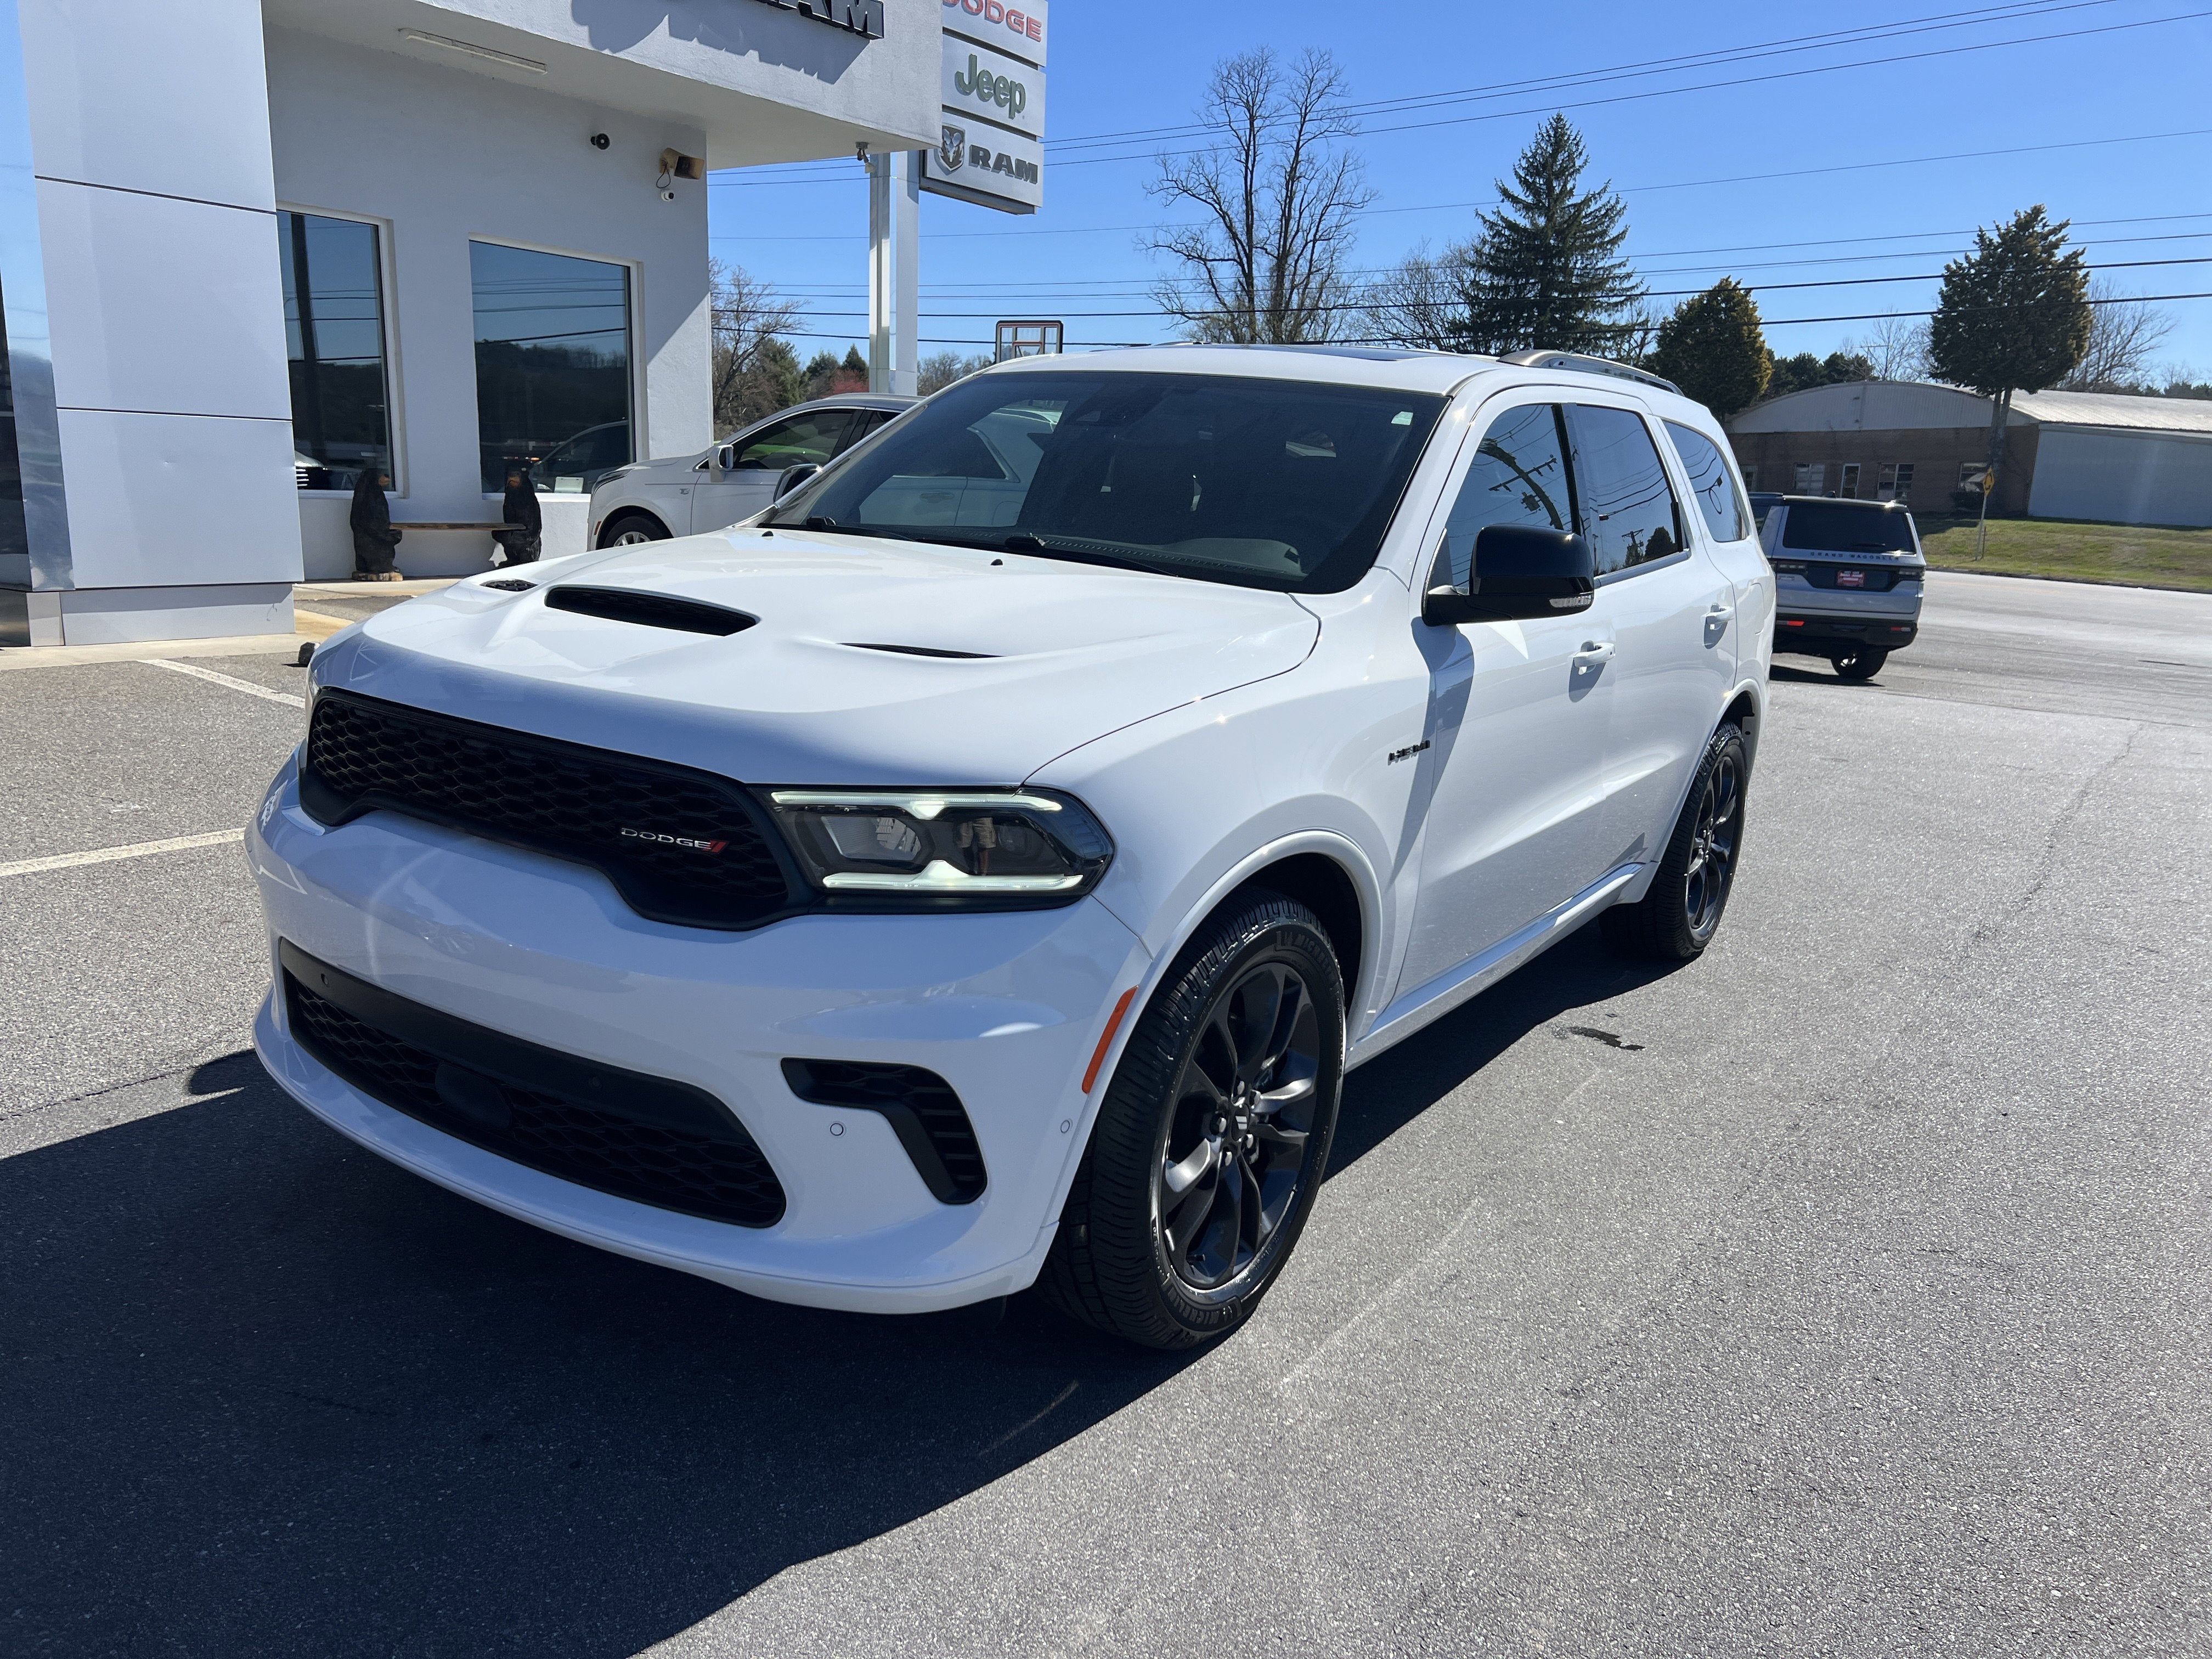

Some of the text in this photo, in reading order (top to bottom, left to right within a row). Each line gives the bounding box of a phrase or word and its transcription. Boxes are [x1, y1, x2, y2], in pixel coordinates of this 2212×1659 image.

[943, 0, 1042, 42] ODGE
[955, 53, 1026, 120] Jeep
[969, 144, 1038, 184] RAM
[621, 827, 712, 850] DODGE
